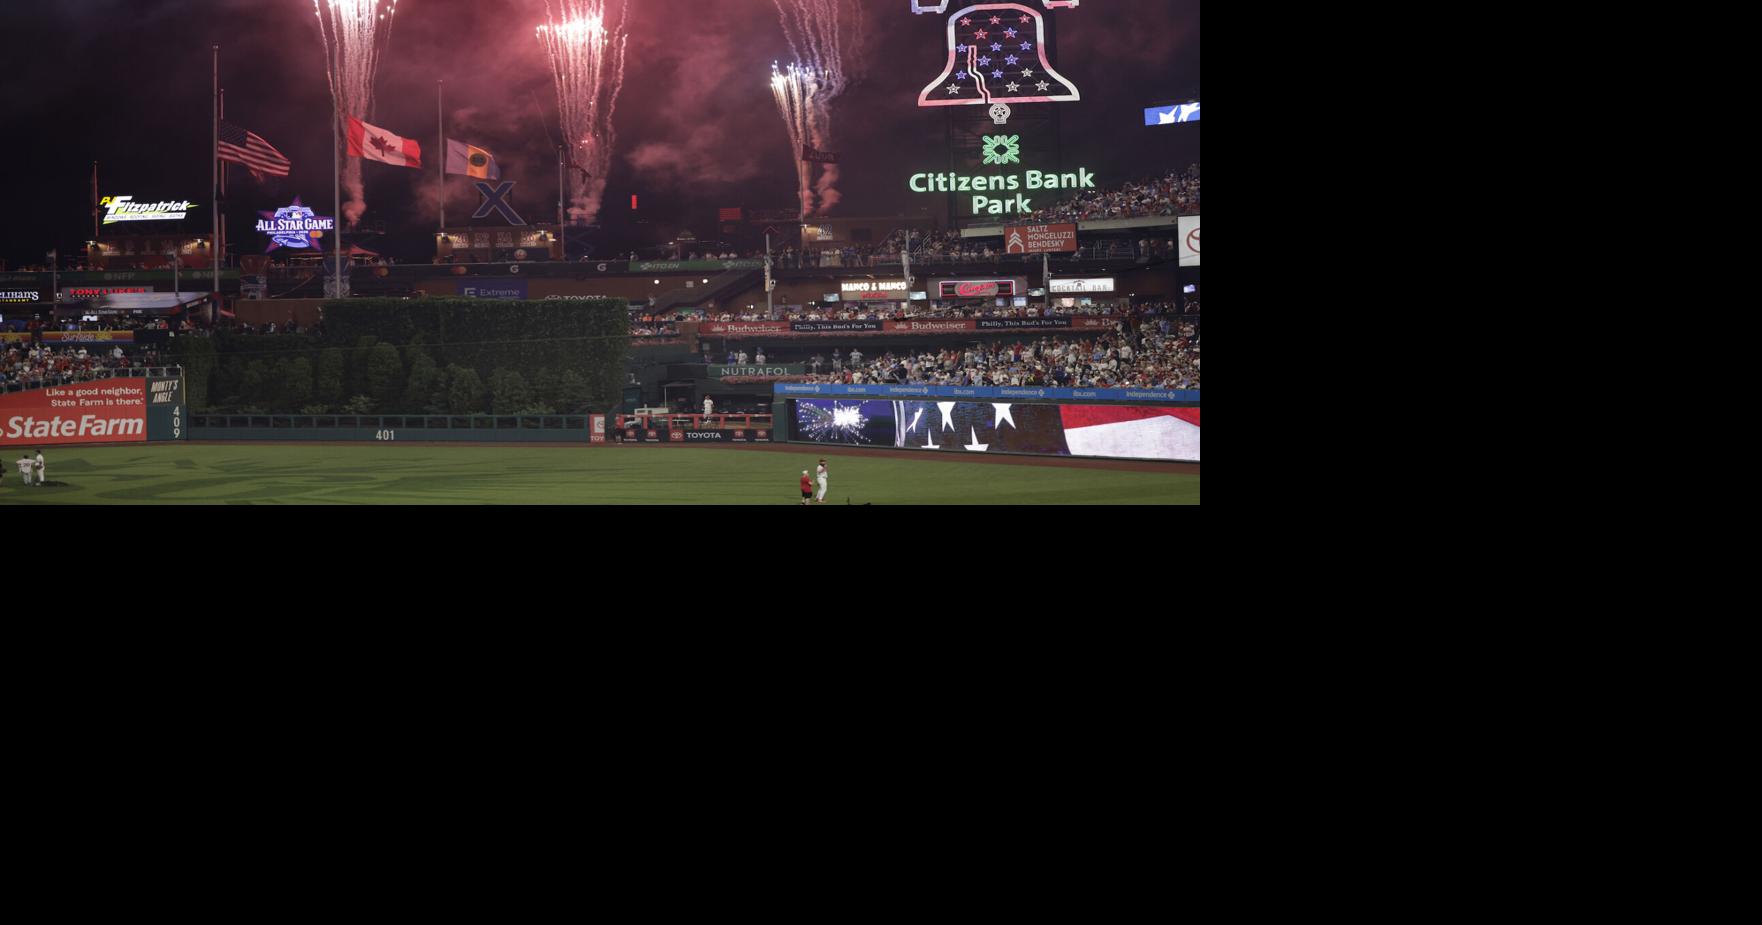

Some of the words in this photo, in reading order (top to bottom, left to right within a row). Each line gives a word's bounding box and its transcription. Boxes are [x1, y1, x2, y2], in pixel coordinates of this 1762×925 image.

[909, 172, 1019, 192] Citizens
[1025, 167, 1095, 189] Bank
[105, 196, 191, 214] Fitzpatrick
[972, 193, 1032, 214] Park
[256, 219, 277, 231] ALL
[277, 219, 304, 231] STAR
[304, 218, 334, 230] GAME
[1027, 225, 1049, 233] SALTZ
[1028, 231, 1074, 241] MONGELUZZI
[1028, 240, 1065, 248] BENDESKY
[841, 283, 870, 291] MANCO
[879, 282, 907, 291] MANCO
[480, 288, 520, 296] Extreme
[727, 324, 783, 332] Budweiser
[911, 321, 966, 329] Budweiser
[721, 367, 790, 376] NUTRAFOL
[46, 388, 66, 396] Like
[76, 388, 98, 397] good
[152, 391, 173, 403] ANGLE
[1126, 390, 1168, 398] Independence
[51, 399, 76, 407] State
[7, 415, 77, 438] State
[78, 414, 143, 437] Farm
[376, 430, 395, 441] 401
